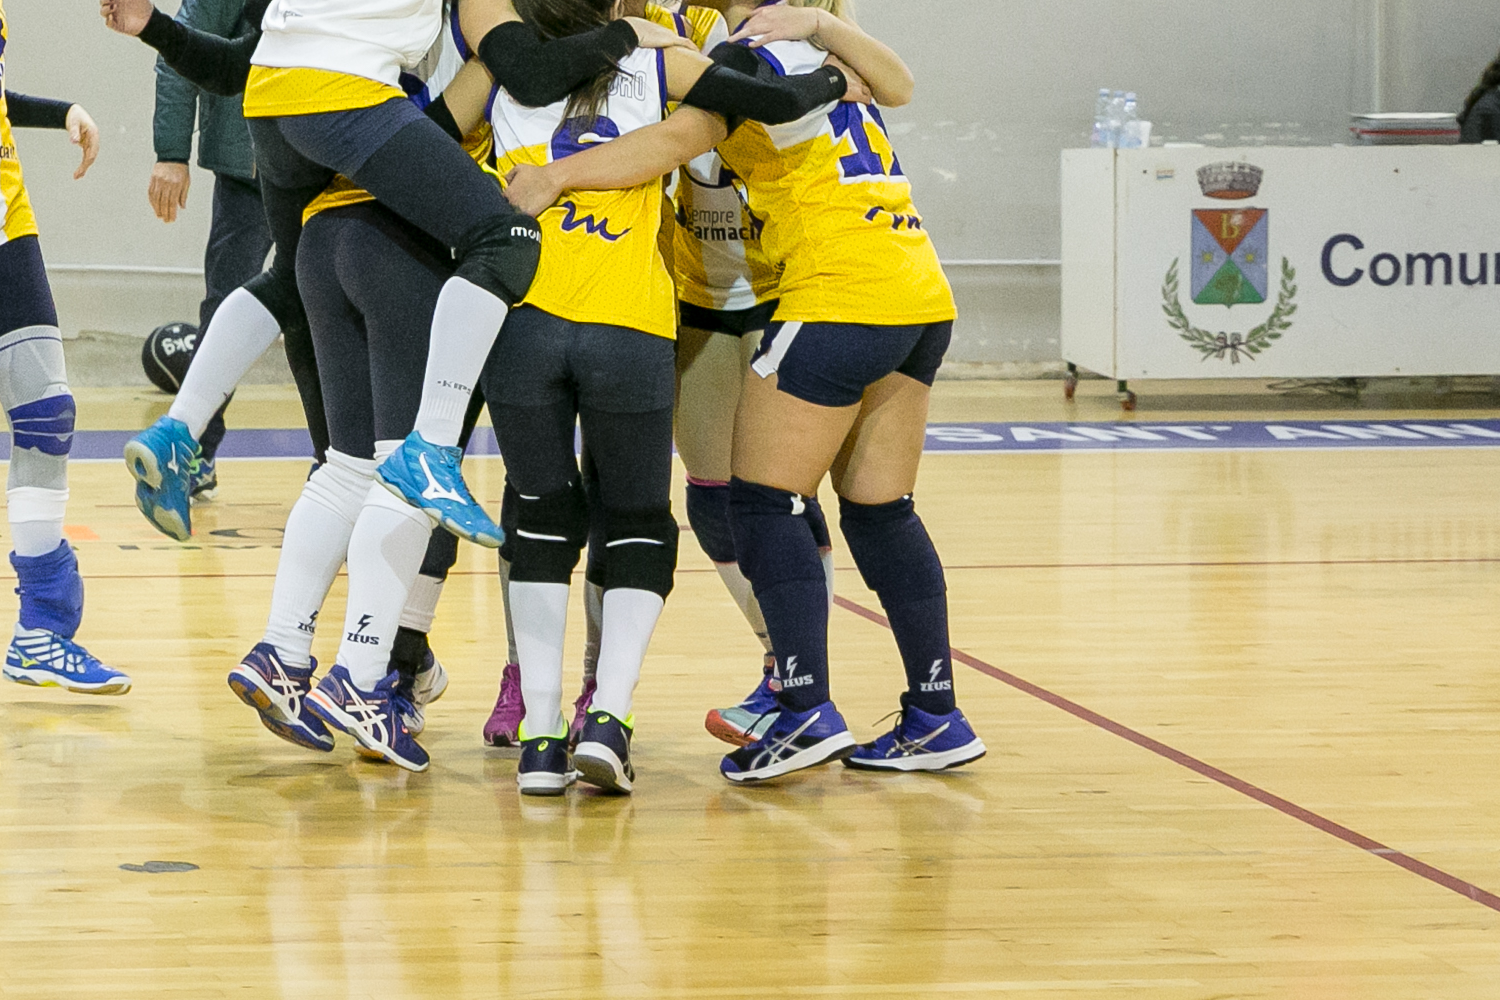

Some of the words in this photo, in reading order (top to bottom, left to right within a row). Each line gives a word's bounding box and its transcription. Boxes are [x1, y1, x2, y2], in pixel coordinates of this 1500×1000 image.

[347, 632, 380, 645] ZEUS
[783, 674, 814, 688] ZEUS
[920, 680, 951, 692] ZEUS
